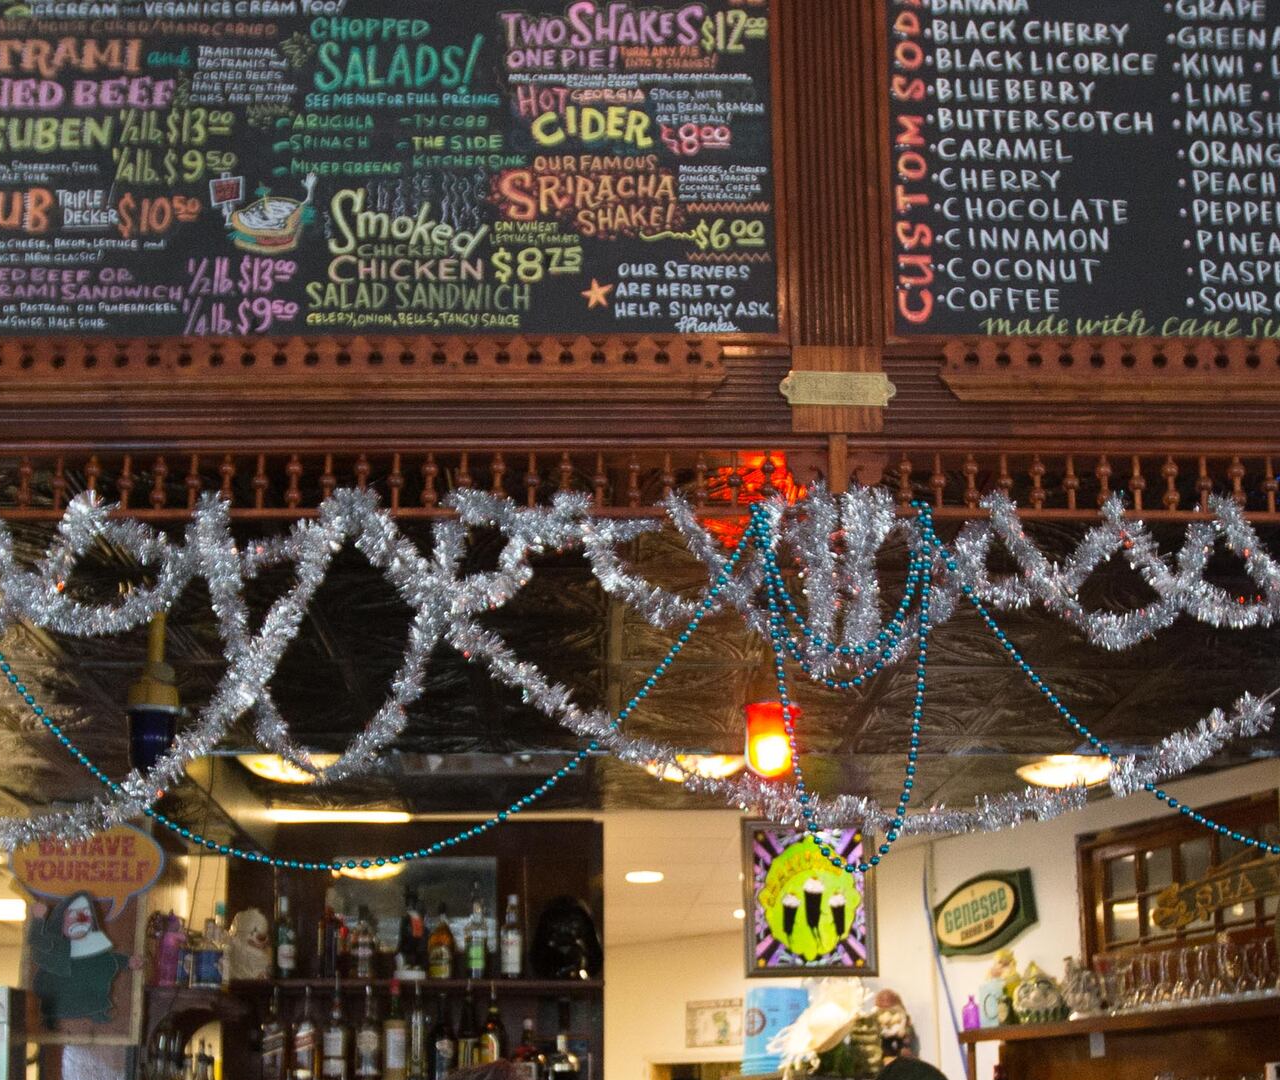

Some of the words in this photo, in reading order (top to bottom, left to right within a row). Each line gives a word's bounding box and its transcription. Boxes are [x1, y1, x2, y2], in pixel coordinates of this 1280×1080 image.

[145, 0, 199, 16] VEGAN
[235, 0, 296, 16] CREAM
[1175, 0, 1267, 22] GRAPE
[310, 16, 431, 42] CHOPPED
[500, 12, 568, 49] TWO
[568, 1, 705, 48] SHAKES
[930, 18, 1018, 46] BLACK
[1022, 20, 1130, 48] CHERRY
[1176, 26, 1267, 50] GREEN
[148, 46, 191, 68] and
[198, 46, 277, 58] TRADITIONAL
[506, 48, 556, 71] ONE
[560, 45, 619, 71] PIE!
[935, 47, 1024, 74] BLACK
[1029, 50, 1159, 77] LICORICE
[197, 58, 266, 69] PASTRAMIS
[313, 32, 486, 94] SALADS!
[1181, 51, 1245, 79] KIWI
[194, 71, 242, 81] CORNED
[72, 76, 176, 108] BEEF
[192, 81, 219, 92] HAVE
[225, 82, 246, 92] FAT
[694, 88, 723, 100] WITH
[935, 77, 1096, 105] BLUEBERRY
[1184, 81, 1253, 107] LIME
[304, 93, 329, 108] SEE
[332, 93, 377, 107] MENU
[379, 93, 404, 105] FOR
[407, 93, 438, 104] FULL
[441, 92, 501, 105] PRICING
[516, 84, 570, 119] HOT
[570, 89, 646, 103] GEORGIA
[655, 102, 677, 113] JIM
[716, 102, 765, 113] KRAKEN
[292, 113, 375, 130] ARUGULA
[438, 114, 488, 129] COBB
[531, 104, 654, 150] CIDER
[671, 112, 733, 124] FIREBALL!
[936, 106, 1156, 136] BUTTERSCOTCH
[288, 133, 370, 151] SPINACH
[411, 135, 446, 151] THE
[449, 134, 504, 150] SIDE
[936, 137, 1073, 164] CARAMEL
[290, 158, 339, 174] MIXED
[342, 160, 403, 175] GREENS
[412, 154, 488, 169] KITCHEN
[488, 153, 528, 169] SINK
[533, 154, 578, 171] OUR
[579, 154, 658, 171] FAMOUS
[728, 165, 768, 174] CANDIED
[719, 173, 758, 182] TOASTED
[724, 183, 762, 192] COFFEE
[938, 167, 1062, 192] CHERRY
[1192, 169, 1277, 197] PEACH
[56, 188, 104, 207] TRIPLE
[498, 169, 678, 220] SRIRACHA
[63, 209, 119, 227] DECKER
[575, 203, 678, 238] SHAKE!
[894, 113, 934, 325] CUSTOM
[942, 196, 1129, 225] CHOCOLATE
[327, 187, 490, 258] Smoked
[515, 220, 559, 232] WHEAT
[93, 239, 137, 248] LETTUCE
[538, 233, 580, 244] TOMATO
[943, 226, 1110, 252] CINNAMON
[356, 243, 448, 258] CHICKEN
[30, 268, 91, 283] BEEF
[98, 267, 133, 282] OR
[327, 254, 485, 286] CHICKEN
[617, 262, 659, 277] OUR
[663, 260, 751, 280] SERVERS
[945, 256, 1101, 285] COCONUT
[60, 283, 184, 301] SANDWICH
[305, 281, 388, 311] SALAD
[394, 283, 531, 312] SANDWICH
[615, 281, 654, 298] ARE
[655, 283, 702, 299] HERE
[704, 283, 735, 298] TO
[945, 286, 1061, 313] COFFEE
[20, 302, 70, 313] PASTRAMI
[98, 301, 178, 313] PUMPERNICKEL
[614, 301, 662, 319] HELP.
[669, 301, 733, 319] SIMPLY
[734, 301, 775, 318] ASK.
[1198, 286, 1272, 315] SOUR
[49, 317, 76, 328] HALF
[306, 311, 357, 327] CELERY,
[357, 312, 397, 326] ONION,
[398, 312, 439, 326] BELLS,
[439, 311, 478, 328] TANGY
[480, 312, 520, 328] SAUCE
[978, 313, 1070, 337] made
[1075, 308, 1157, 337] with
[1161, 315, 1242, 338] cane
[24, 859, 151, 883] YOURSELF
